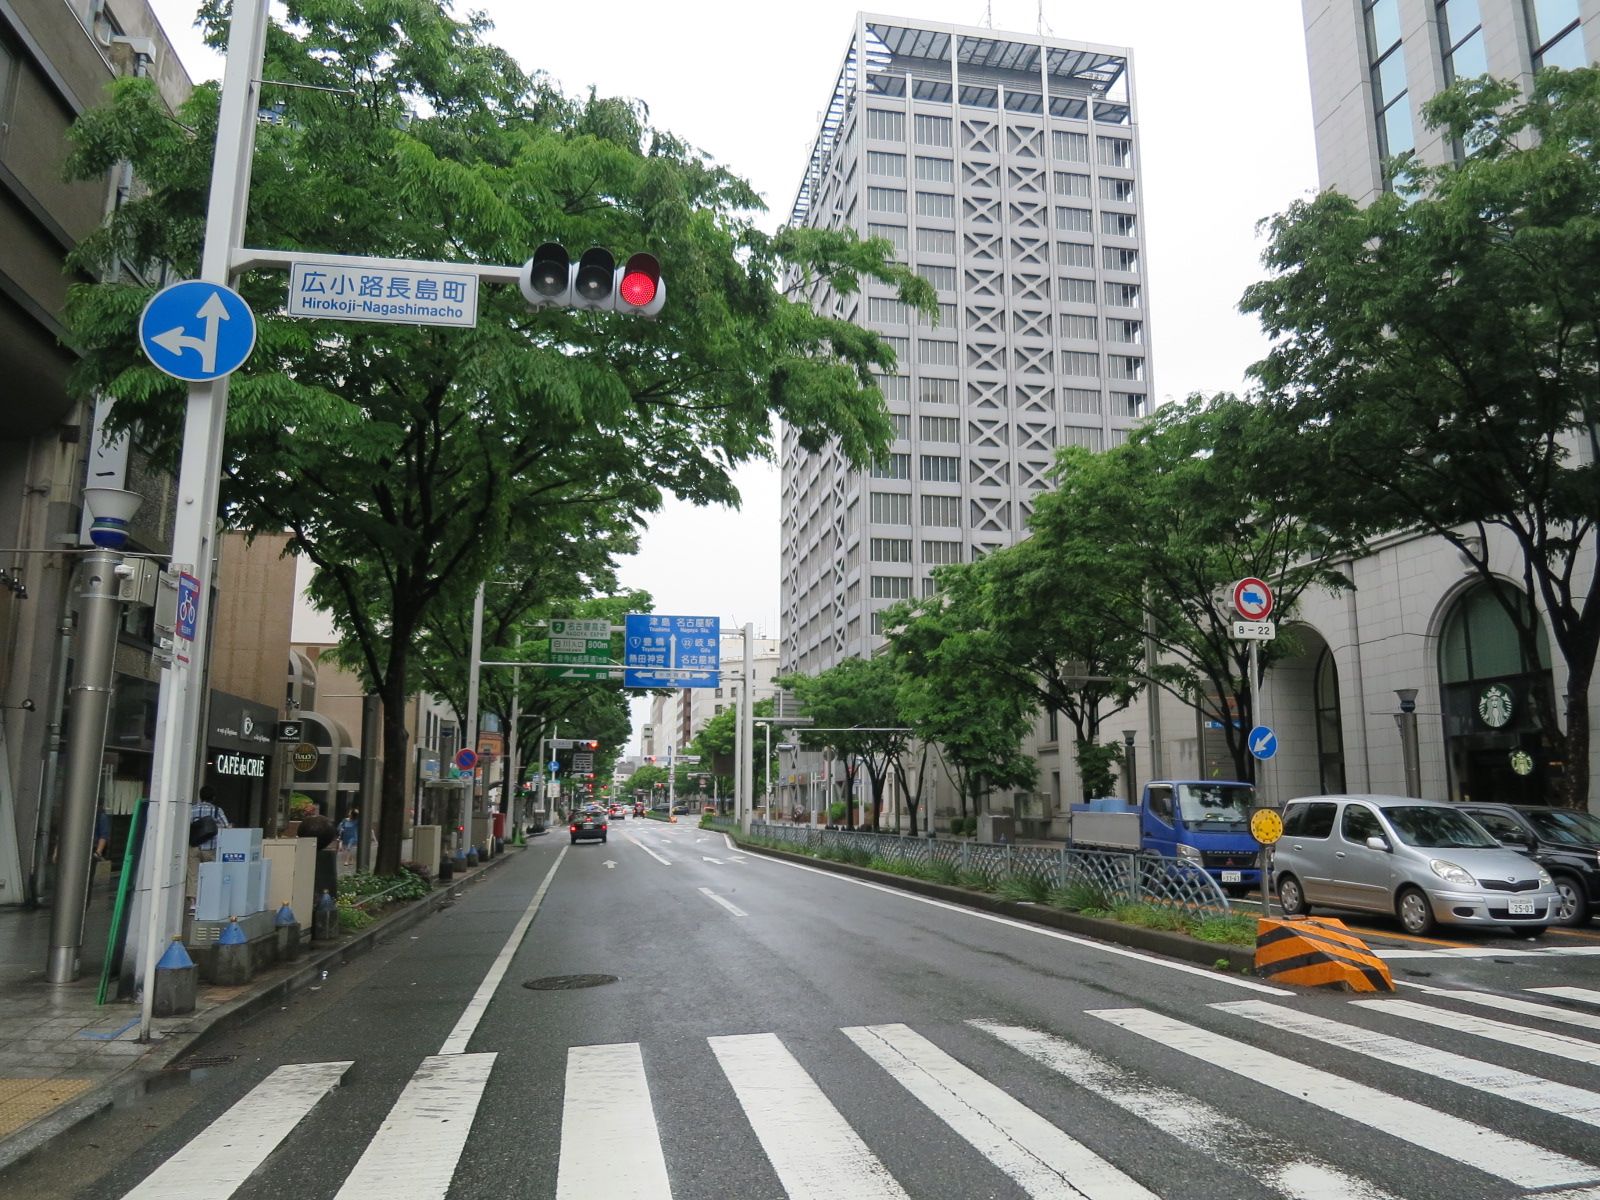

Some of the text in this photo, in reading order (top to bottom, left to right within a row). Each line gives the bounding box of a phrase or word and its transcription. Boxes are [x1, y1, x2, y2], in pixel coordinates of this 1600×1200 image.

[301, 271, 467, 303] 広小路長島町
[302, 297, 463, 318] Hirokoji-Nagashimacho
[555, 623, 562, 631] 2
[677, 618, 714, 628] 名古屋駅
[587, 640, 608, 649] 800m
[629, 654, 664, 664] 熱田神宮
[217, 752, 265, 777] CAFÉ de CRIÉ
